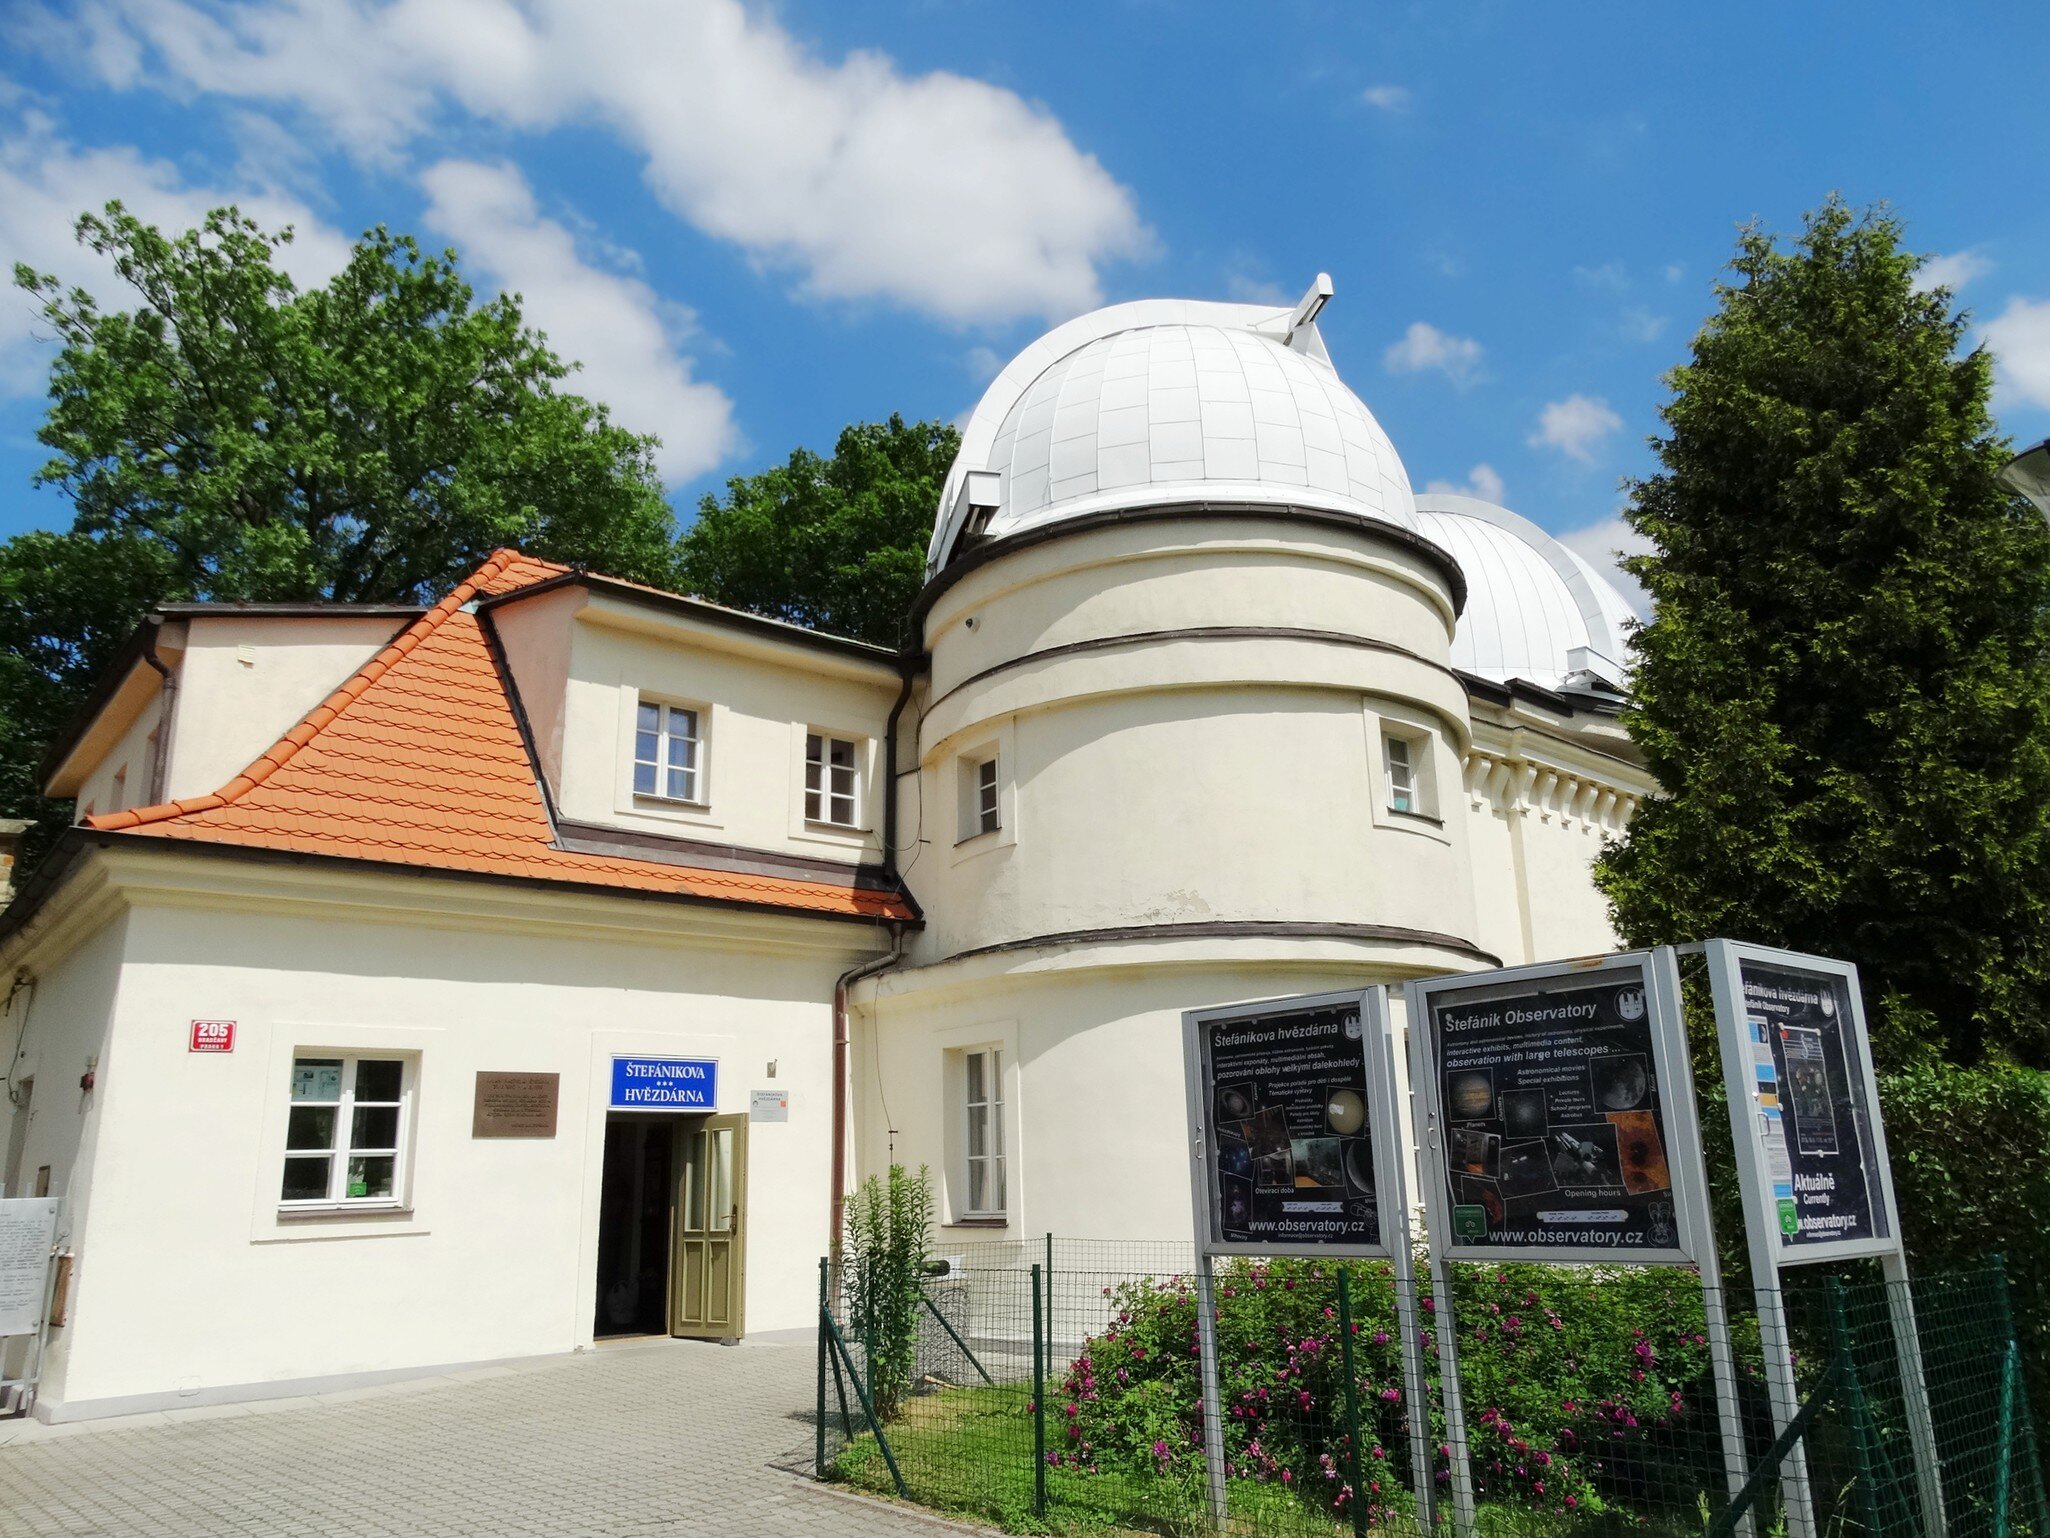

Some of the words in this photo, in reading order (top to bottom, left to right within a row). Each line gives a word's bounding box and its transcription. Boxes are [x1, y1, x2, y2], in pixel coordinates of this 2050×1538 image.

[1505, 1004, 1597, 1025] Observatory
[198, 1023, 229, 1037] 205
[1215, 1031, 1275, 1047] Štefánikova
[1278, 1023, 1338, 1040] hvězdárna
[1447, 1047, 1482, 1056] interactive
[1483, 1044, 1511, 1054] exhibits,
[1513, 1041, 1553, 1050] multimedia
[1553, 1037, 1584, 1047] content,
[1446, 1056, 1502, 1068] observation
[1504, 1052, 1524, 1062] with
[1526, 1050, 1551, 1061] large
[1553, 1045, 1609, 1058] telescopes
[626, 1062, 706, 1079] ŠTEFÁNIKOVA
[1217, 1068, 1254, 1081] pozorování
[1255, 1065, 1282, 1077] oblohy
[1282, 1062, 1312, 1074] velkými
[1312, 1057, 1361, 1070] dalekohledy
[1517, 1066, 1560, 1076] Astronomical
[1561, 1064, 1586, 1072] movies
[1517, 1077, 1542, 1086] Special
[1542, 1075, 1580, 1083] exhibitions
[625, 1086, 705, 1103] HVĚZDÁRNA
[1280, 1186, 1295, 1194] doba
[1794, 1172, 1835, 1191] Aktuálně
[1564, 1189, 1597, 1198] Opening
[1598, 1188, 1621, 1197] hours
[1803, 1193, 1830, 1206] Currently
[1248, 1218, 1365, 1235] www.observatory.cz
[1489, 1229, 1643, 1247] www.observatory.cz
